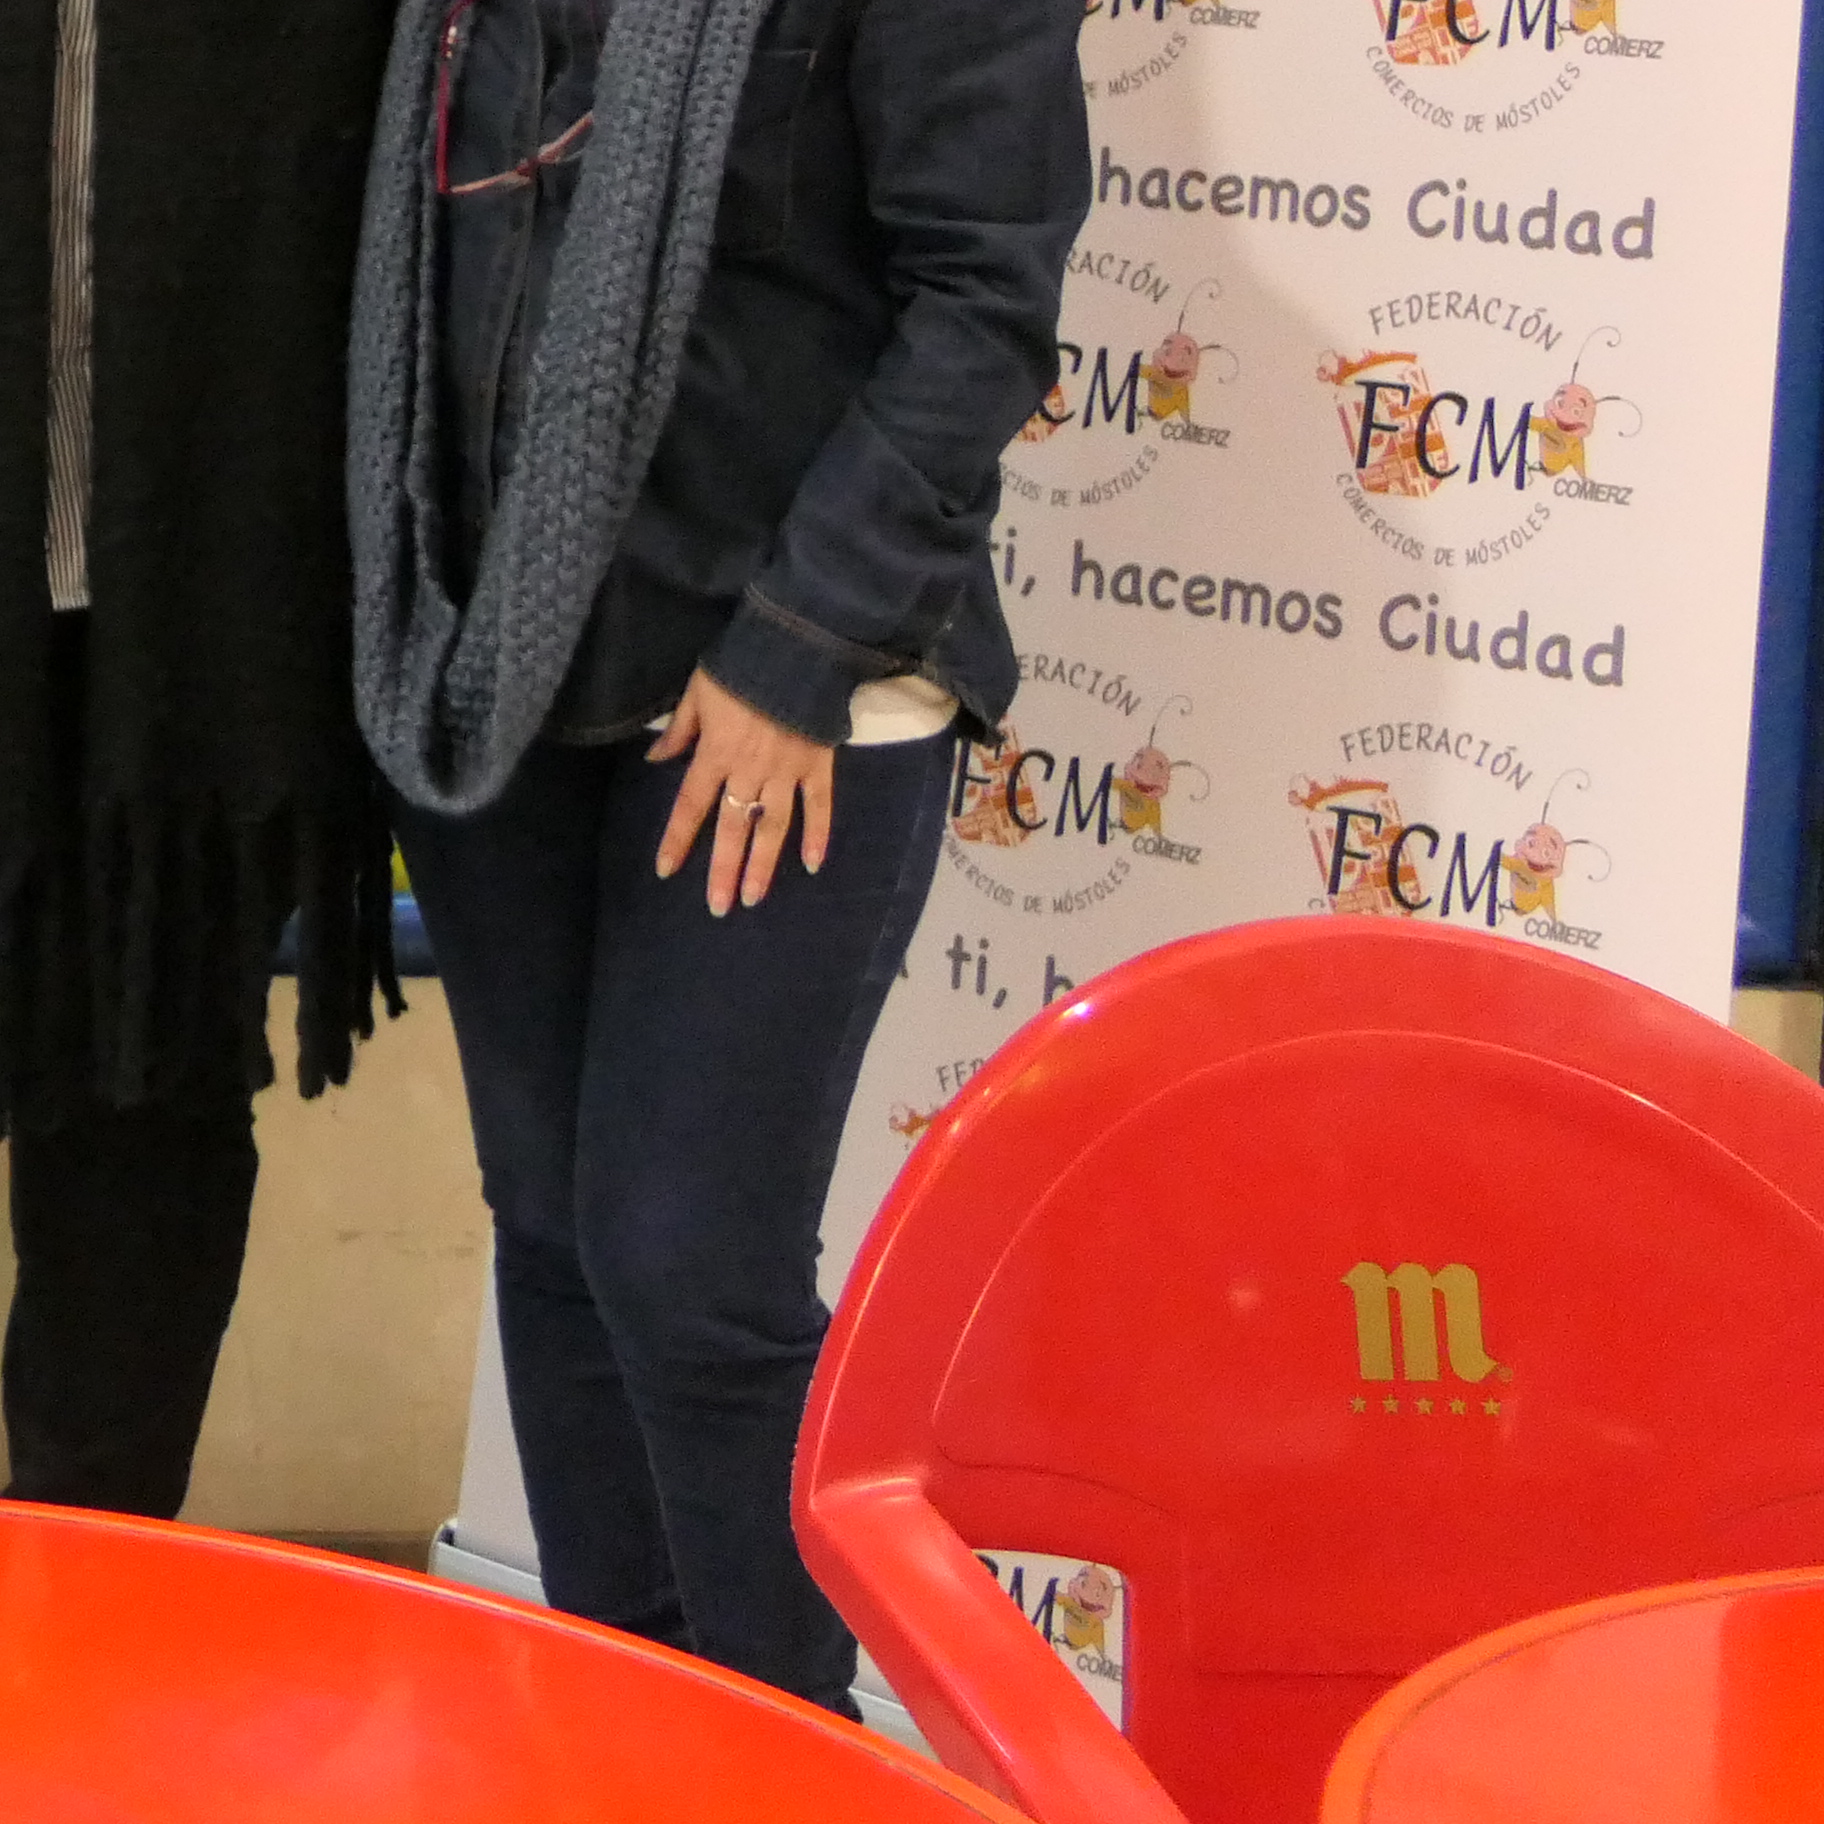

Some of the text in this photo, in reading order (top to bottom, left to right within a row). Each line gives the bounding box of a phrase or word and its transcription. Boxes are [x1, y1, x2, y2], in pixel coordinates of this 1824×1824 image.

[1366, 45, 1580, 133] COMERCIOS DE MÓSTOLES
[1100, 147, 1655, 259] hacemos Ciudad
[1369, 291, 1562, 351] FEDERACIÓN
[1355, 381, 1537, 490] FCM
[1072, 540, 1625, 687] hacemos Ciudad
[1337, 722, 1532, 792] FEDERACIÓN
[1327, 806, 1504, 927] FCM
[946, 935, 1007, 1009] ti,
[1338, 1261, 1501, 1384] m
